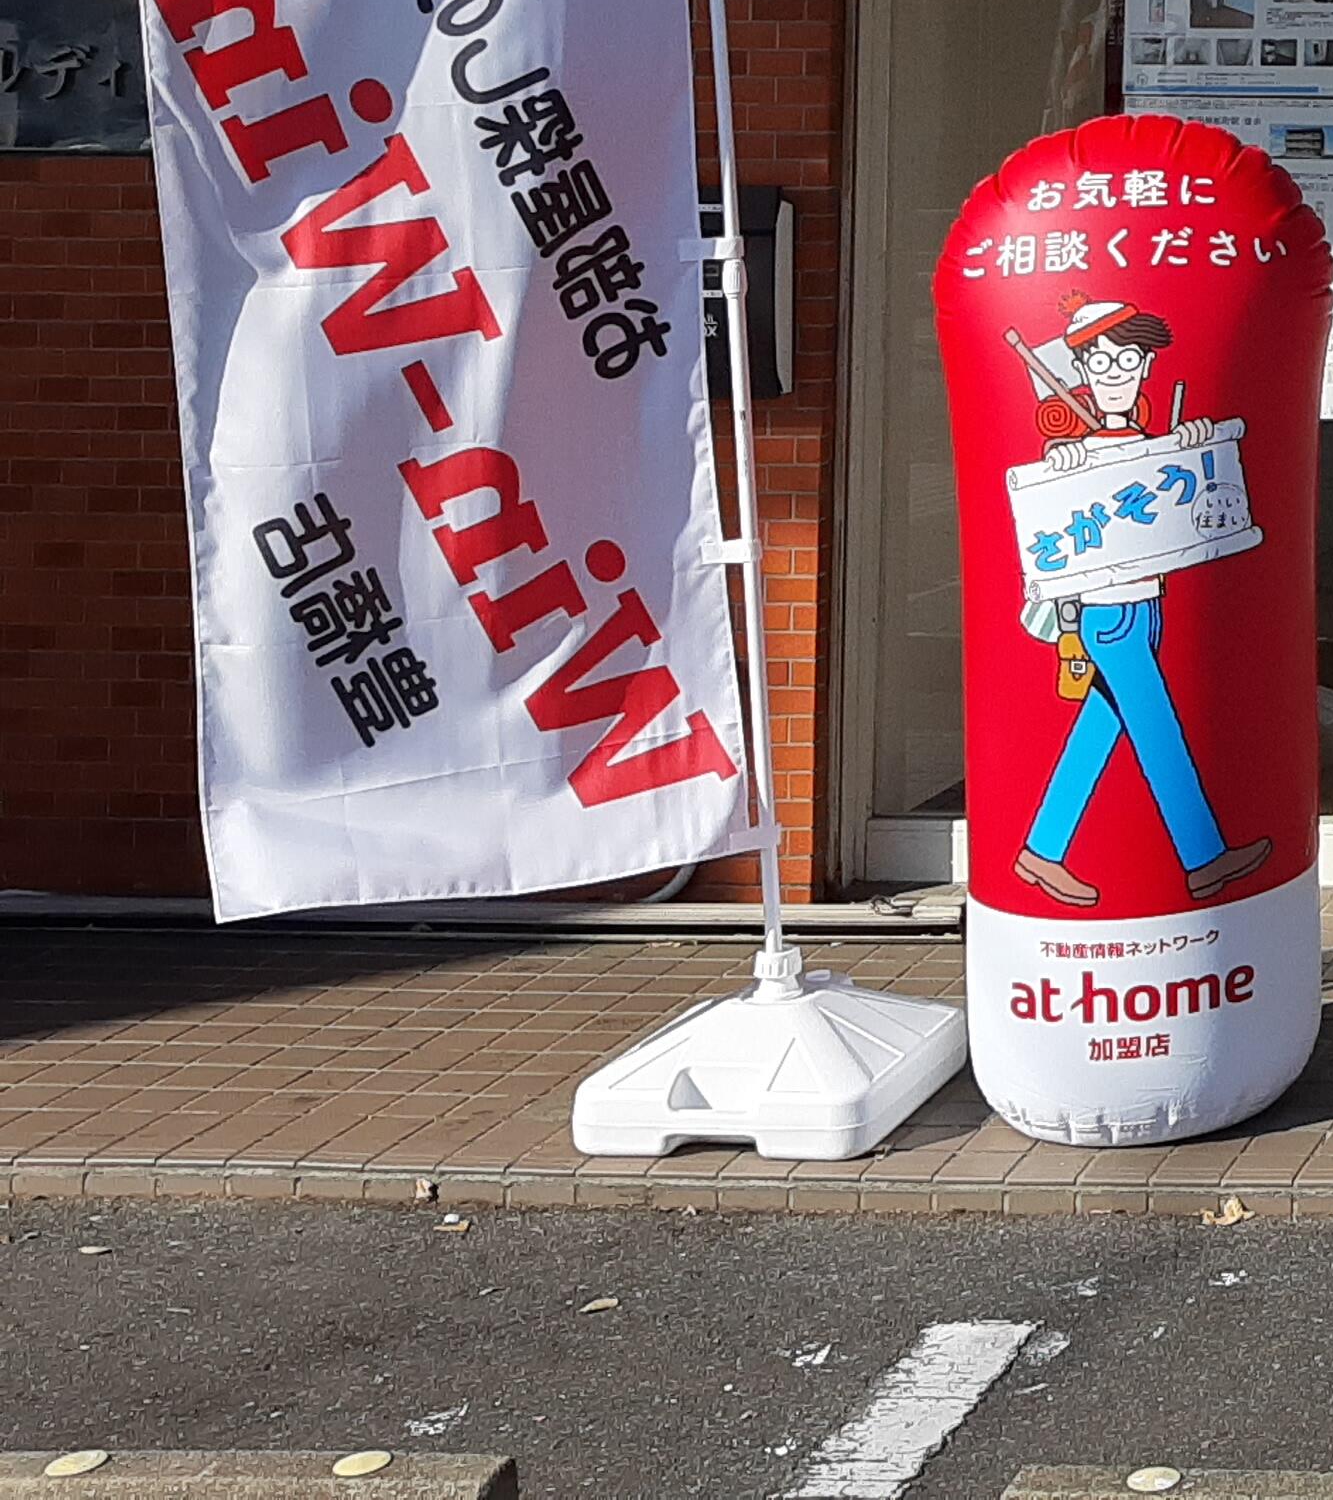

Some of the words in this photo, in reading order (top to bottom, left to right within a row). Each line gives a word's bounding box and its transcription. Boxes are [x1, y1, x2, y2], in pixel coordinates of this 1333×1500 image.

[1027, 169, 1216, 213] お気軽に
[962, 227, 1287, 279] ご相談ください
[1195, 511, 1246, 533] 住まい
[1040, 930, 1221, 960] 不動産情報ネットワーク
[1009, 977, 1064, 1025] at
[1071, 964, 1256, 1025] home
[1088, 1033, 1171, 1062] 加盟店
